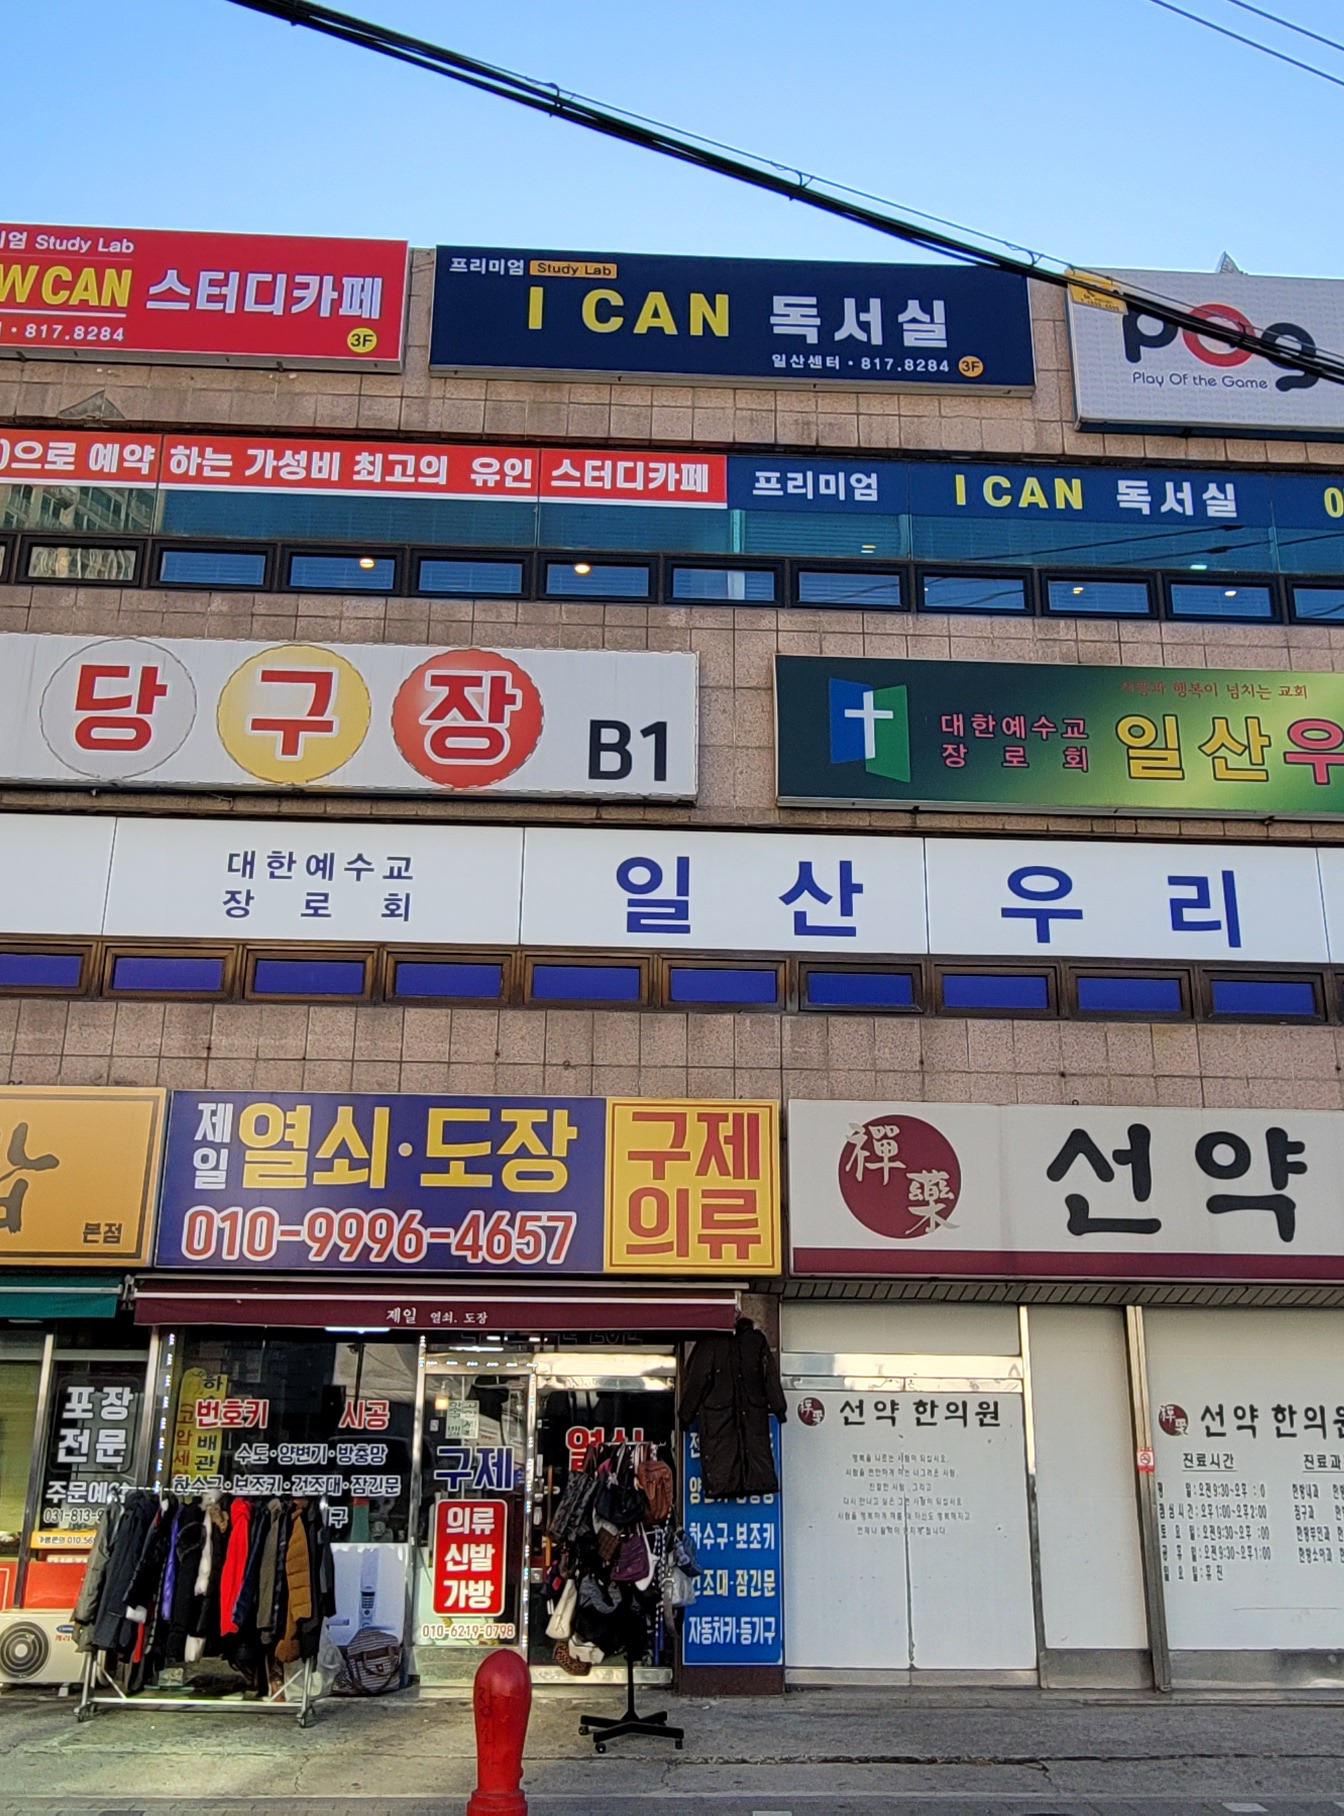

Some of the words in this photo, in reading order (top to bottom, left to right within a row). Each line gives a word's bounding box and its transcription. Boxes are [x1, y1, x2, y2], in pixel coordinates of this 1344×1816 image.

[34, 234, 92, 253] Study
[97, 237, 135, 254] Lab
[448, 257, 525, 276] 프리미엄
[537, 263, 578, 278] Study
[583, 264, 613, 279] Lab
[40, 264, 133, 308] CAN
[145, 267, 384, 320] 스터디카페
[527, 285, 544, 331] I
[580, 287, 730, 338] CAN
[768, 293, 949, 349] 독서실
[24, 323, 125, 343] 817.8284
[349, 331, 375, 349] 3F
[770, 353, 841, 371] 일산센터
[860, 357, 950, 374] 817.8284
[959, 361, 981, 375] 3F
[1131, 369, 1167, 390] Play
[1169, 370, 1189, 385] Of
[1190, 373, 1218, 387] the
[1220, 375, 1269, 391] Game
[88, 441, 156, 476] 예약
[169, 444, 233, 479] 하는
[244, 448, 341, 482] 가성비
[352, 452, 449, 486] 최고의
[470, 456, 533, 489] 유인
[551, 459, 710, 494] 스터디카페
[752, 470, 879, 502] 프리미엄
[955, 473, 967, 507] I
[982, 475, 1084, 511] CAN
[1116, 480, 1238, 519] 독서실
[1278, 684, 1308, 700] 교회
[72, 662, 518, 764] 당구장
[940, 712, 1090, 741] 대한예수교
[587, 718, 670, 782] B1
[940, 741, 1090, 775] 장로회
[225, 849, 415, 884] 대한예수교
[221, 887, 413, 924] 장로회
[192, 1102, 232, 1190] 제일
[627, 1110, 761, 1181] 구제
[1046, 1122, 1308, 1244] 선약
[82, 1222, 123, 1246] 본점
[181, 1205, 578, 1265] 010-9996-4657
[625, 1186, 763, 1260] 의류
[385, 1307, 418, 1324] 제일
[463, 1311, 489, 1325] 도장
[62, 1386, 134, 1421] 포장
[195, 1398, 270, 1429] 번호키
[339, 1399, 390, 1430] 시공
[839, 1399, 900, 1428] 선약
[912, 1399, 1001, 1428] 한의원
[1200, 1403, 1259, 1440] 선약
[57, 1428, 127, 1463] 전문
[1182, 1452, 1236, 1470] 진료시간
[434, 1445, 515, 1492] 구제
[846, 1468, 865, 1477] 사람을
[445, 1507, 495, 1535] 의류
[444, 1543, 496, 1572] 신발
[443, 1579, 495, 1609] 가방
[421, 1623, 516, 1639] 010-6219-0798
